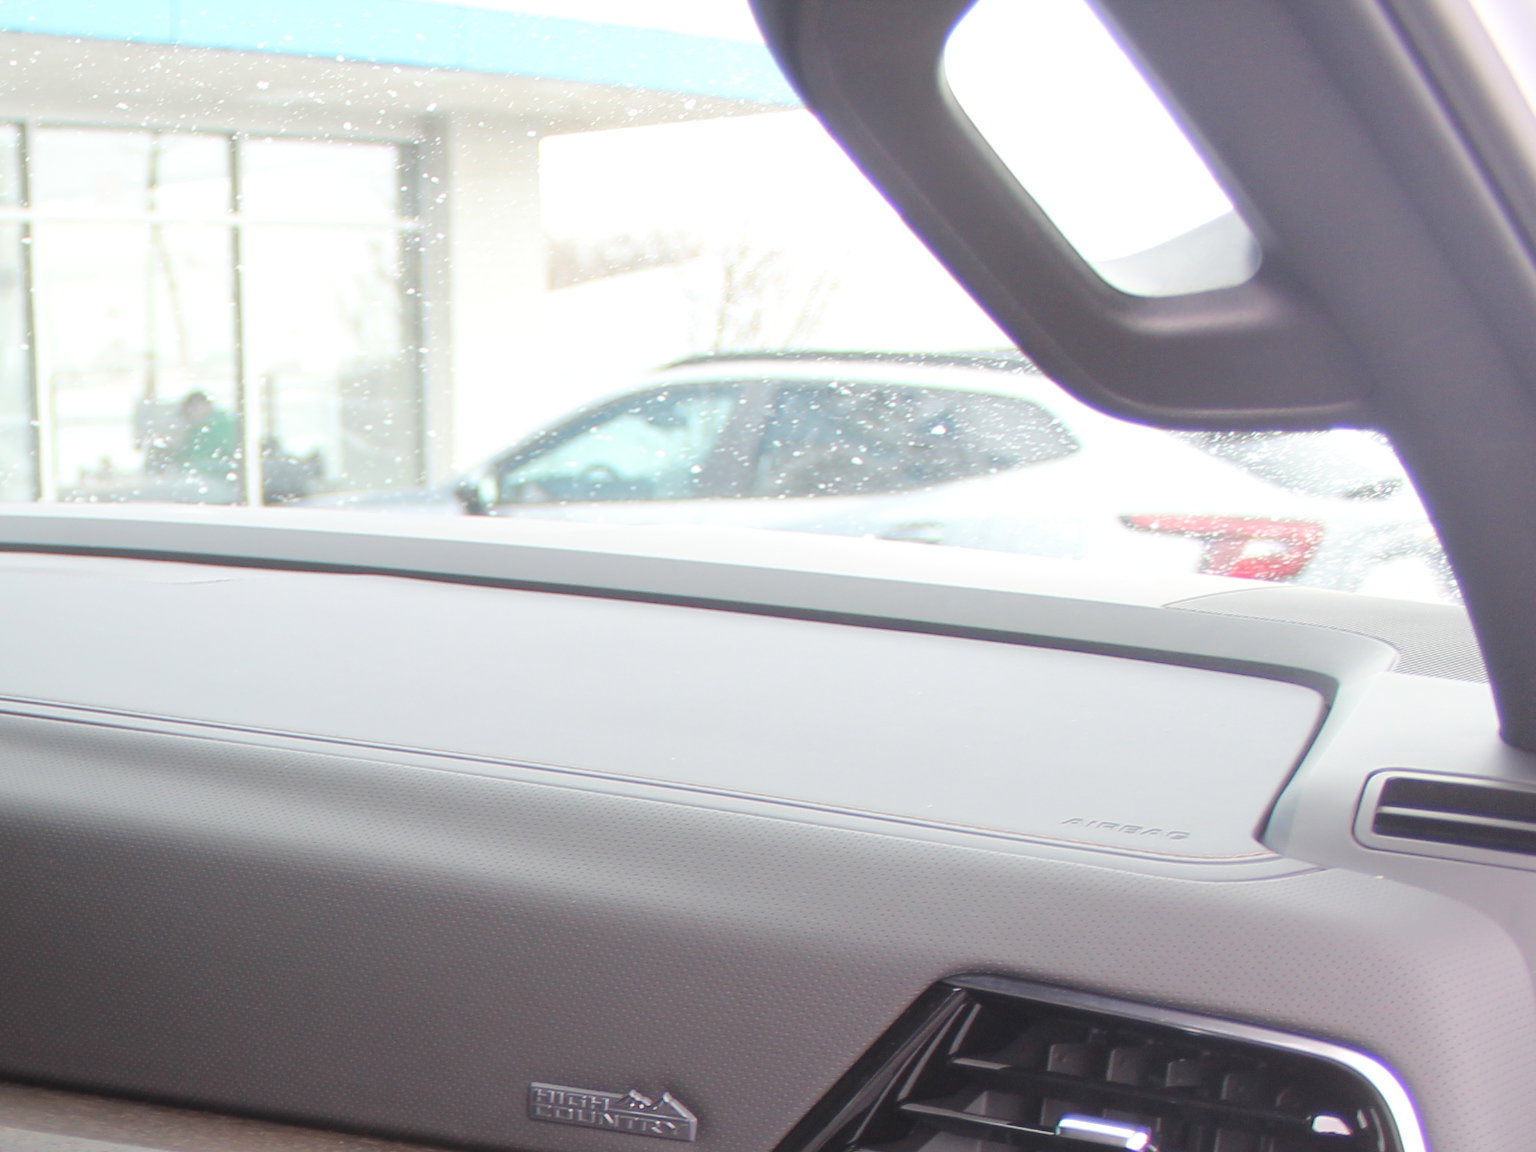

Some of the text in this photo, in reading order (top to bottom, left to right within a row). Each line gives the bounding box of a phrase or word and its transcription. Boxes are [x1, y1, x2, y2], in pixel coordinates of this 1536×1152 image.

[1060, 817, 1191, 841] AIRBAG
[533, 1088, 609, 1111] HIGH
[532, 1104, 689, 1136] COUNTRY
